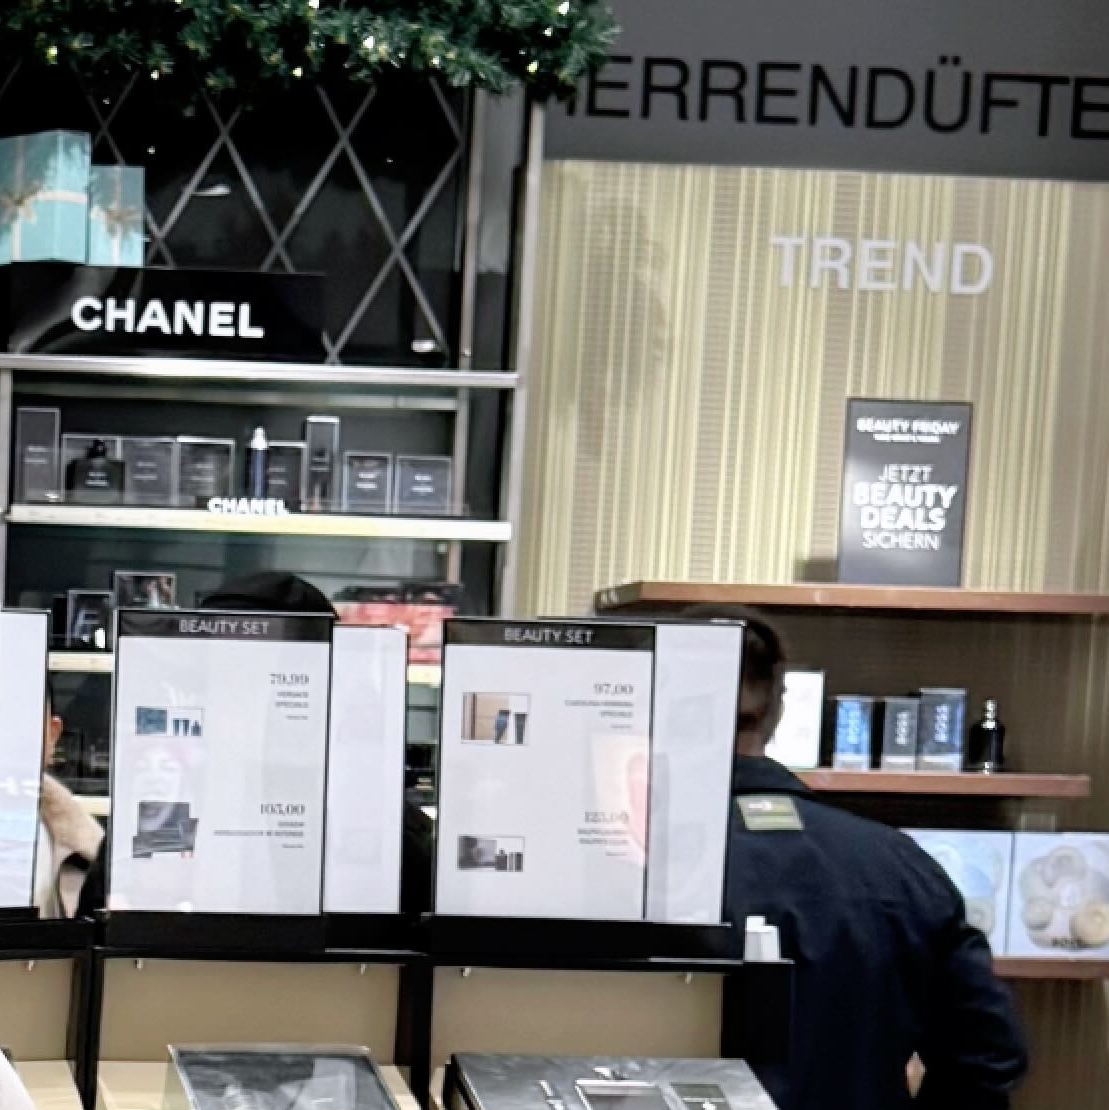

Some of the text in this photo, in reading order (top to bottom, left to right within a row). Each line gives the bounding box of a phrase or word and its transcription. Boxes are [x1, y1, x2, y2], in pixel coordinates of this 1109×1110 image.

[564, 53, 1109, 141] ERRENDÜFTE
[770, 235, 995, 295] TREND
[71, 296, 266, 339] CHANEL
[878, 464, 933, 482] JETZT
[853, 482, 958, 508] BEAUTY
[207, 497, 289, 515] CHANEL
[861, 507, 946, 531] DEALS
[862, 531, 940, 550] SICHERN
[178, 618, 269, 635] BEAUTY SET
[503, 627, 594, 644] BEAUTY SET
